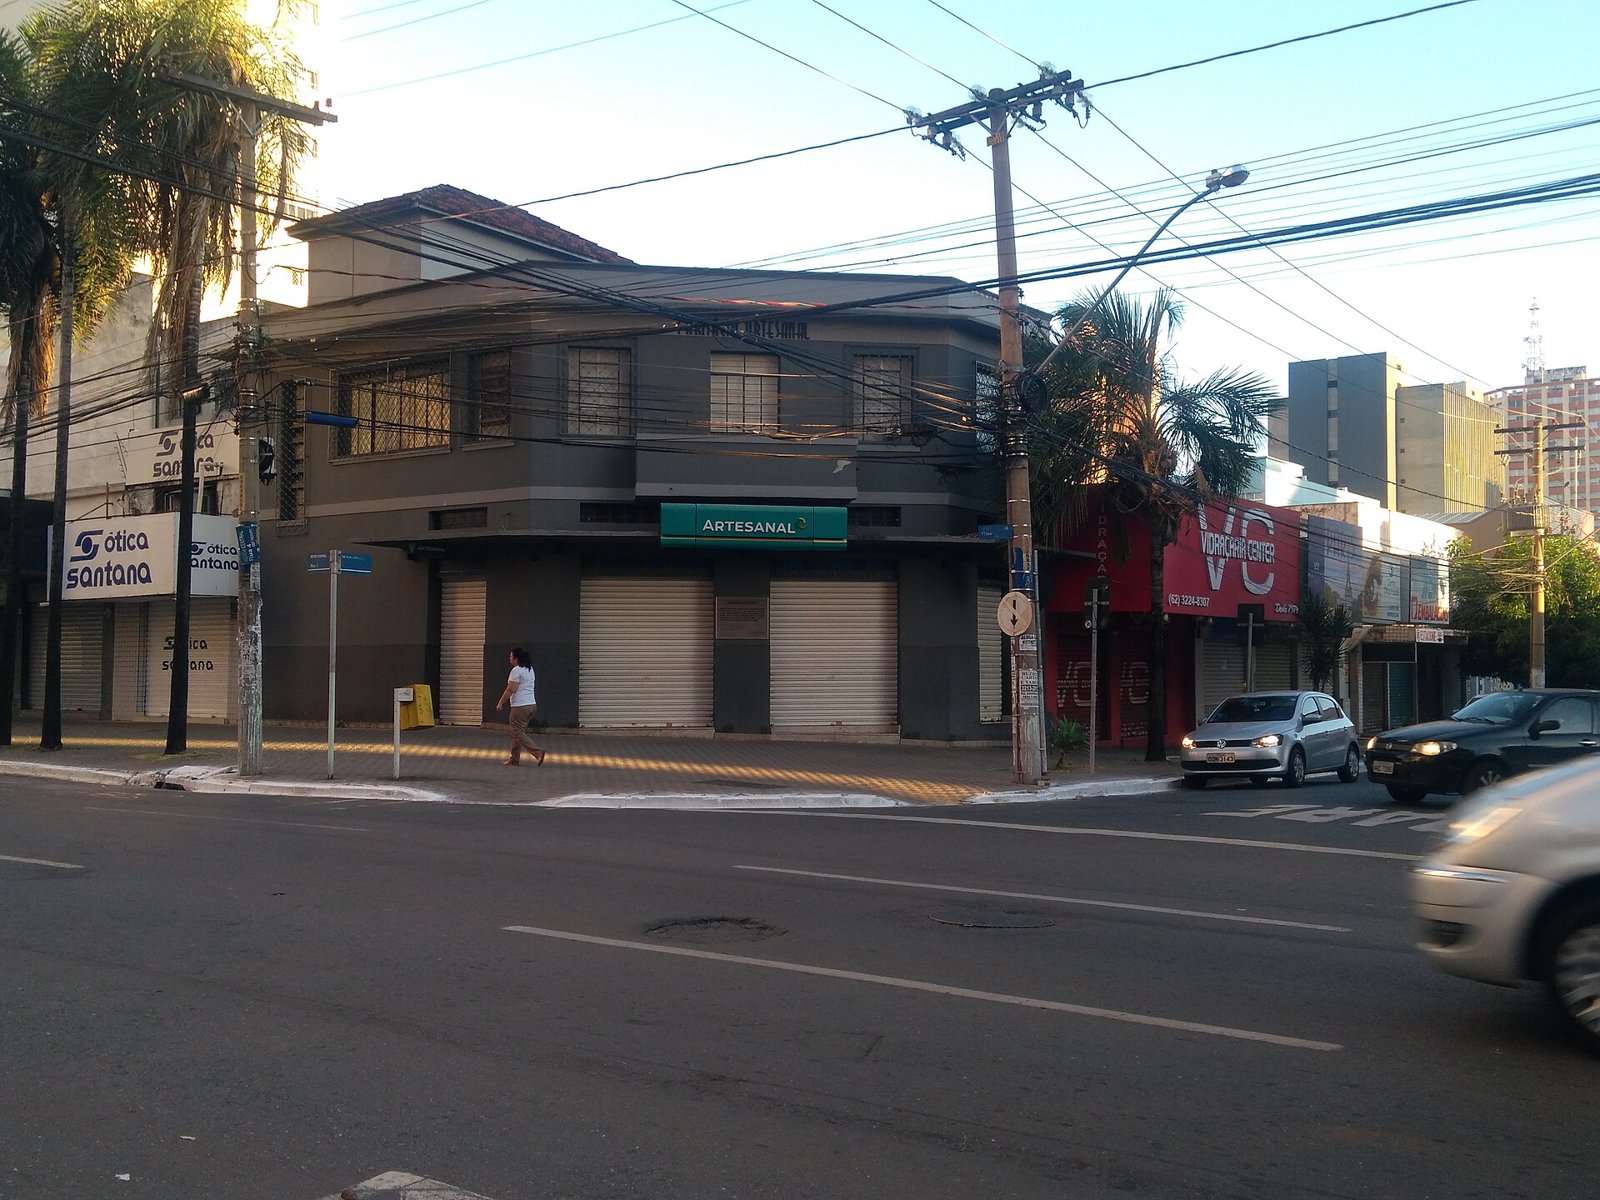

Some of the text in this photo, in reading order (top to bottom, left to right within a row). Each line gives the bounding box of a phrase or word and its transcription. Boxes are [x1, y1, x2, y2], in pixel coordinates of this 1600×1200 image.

[153, 457, 214, 477] sanna
[702, 519, 796, 534] ARTESANAL
[104, 530, 149, 553] ótica
[1201, 531, 1275, 564] VIDRAÇARIA CENTER
[207, 543, 238, 556] ótica
[191, 557, 239, 570] antana
[66, 560, 152, 589] santana
[1168, 593, 1181, 607] (62)
[189, 637, 208, 650] ica
[162, 660, 214, 671] sana
